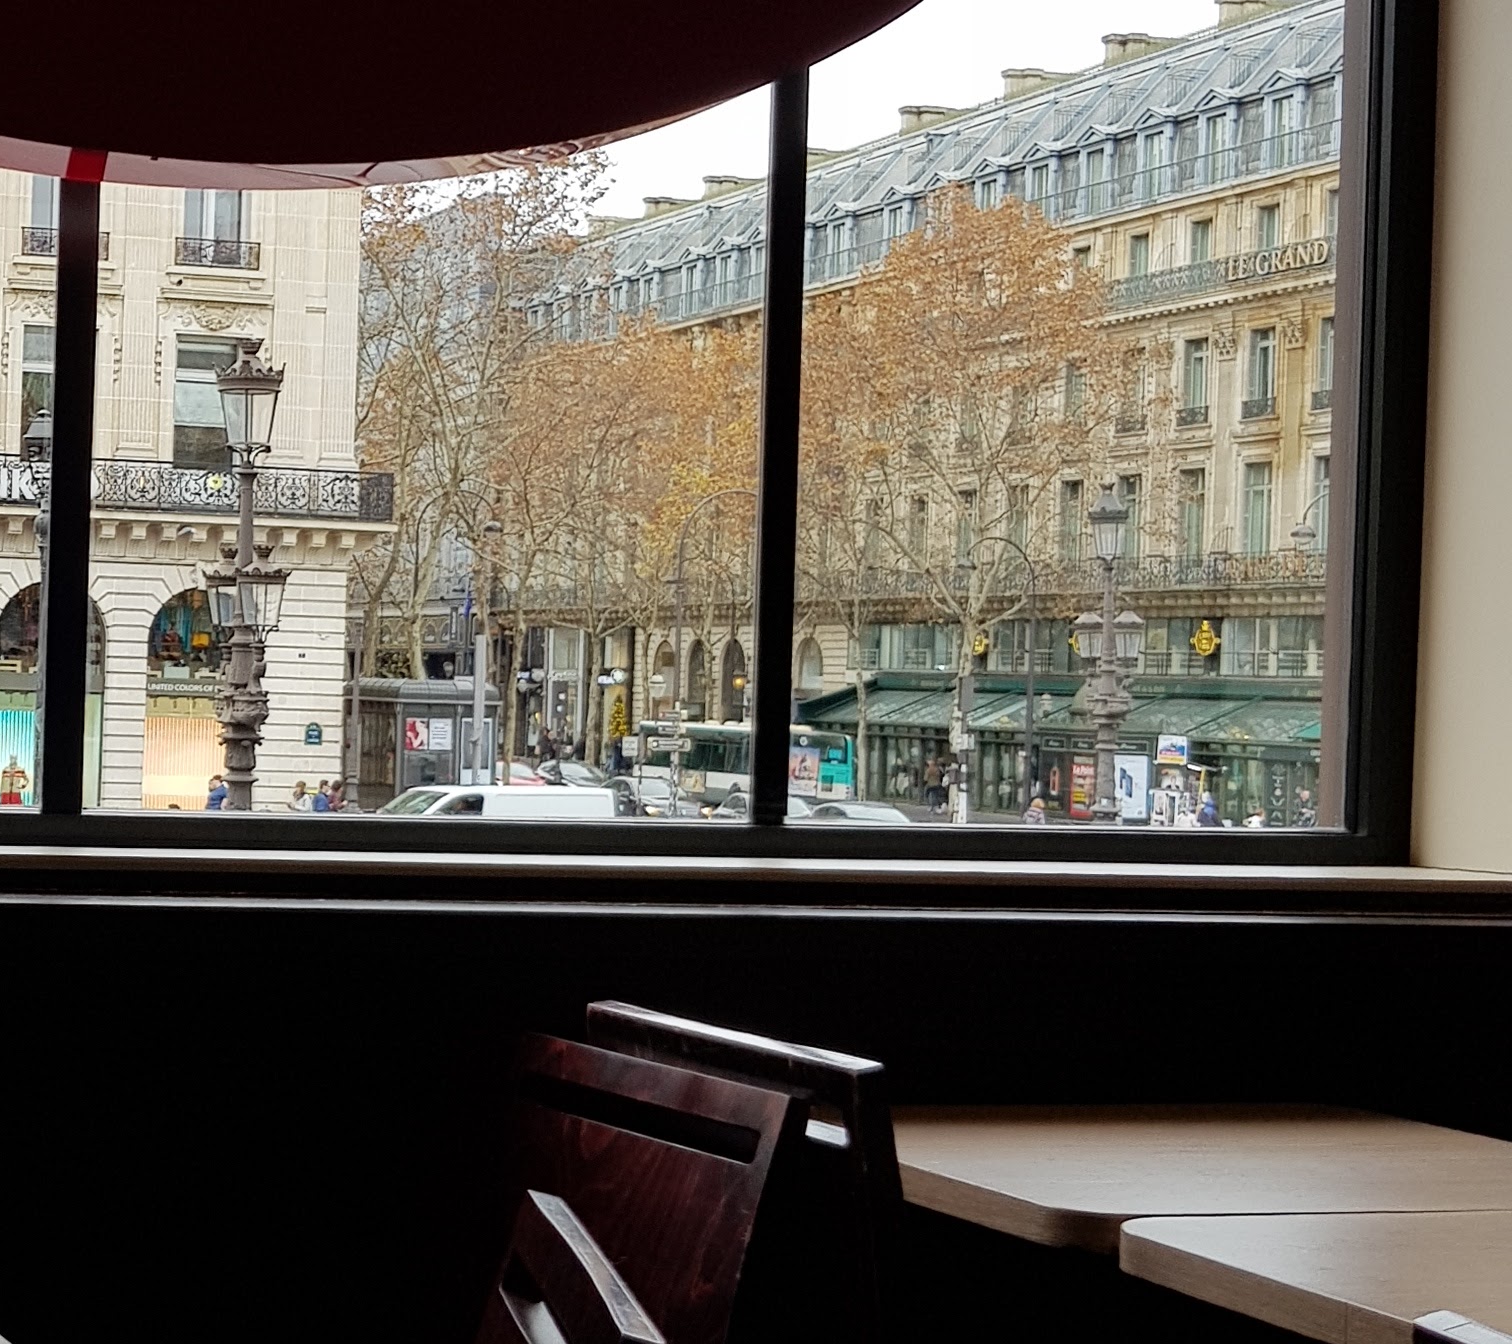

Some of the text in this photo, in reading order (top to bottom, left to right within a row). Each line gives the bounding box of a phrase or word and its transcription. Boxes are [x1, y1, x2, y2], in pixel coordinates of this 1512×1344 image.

[148, 683, 174, 691] UNITED
[174, 683, 203, 692] COLORS
[203, 684, 214, 692] OF
